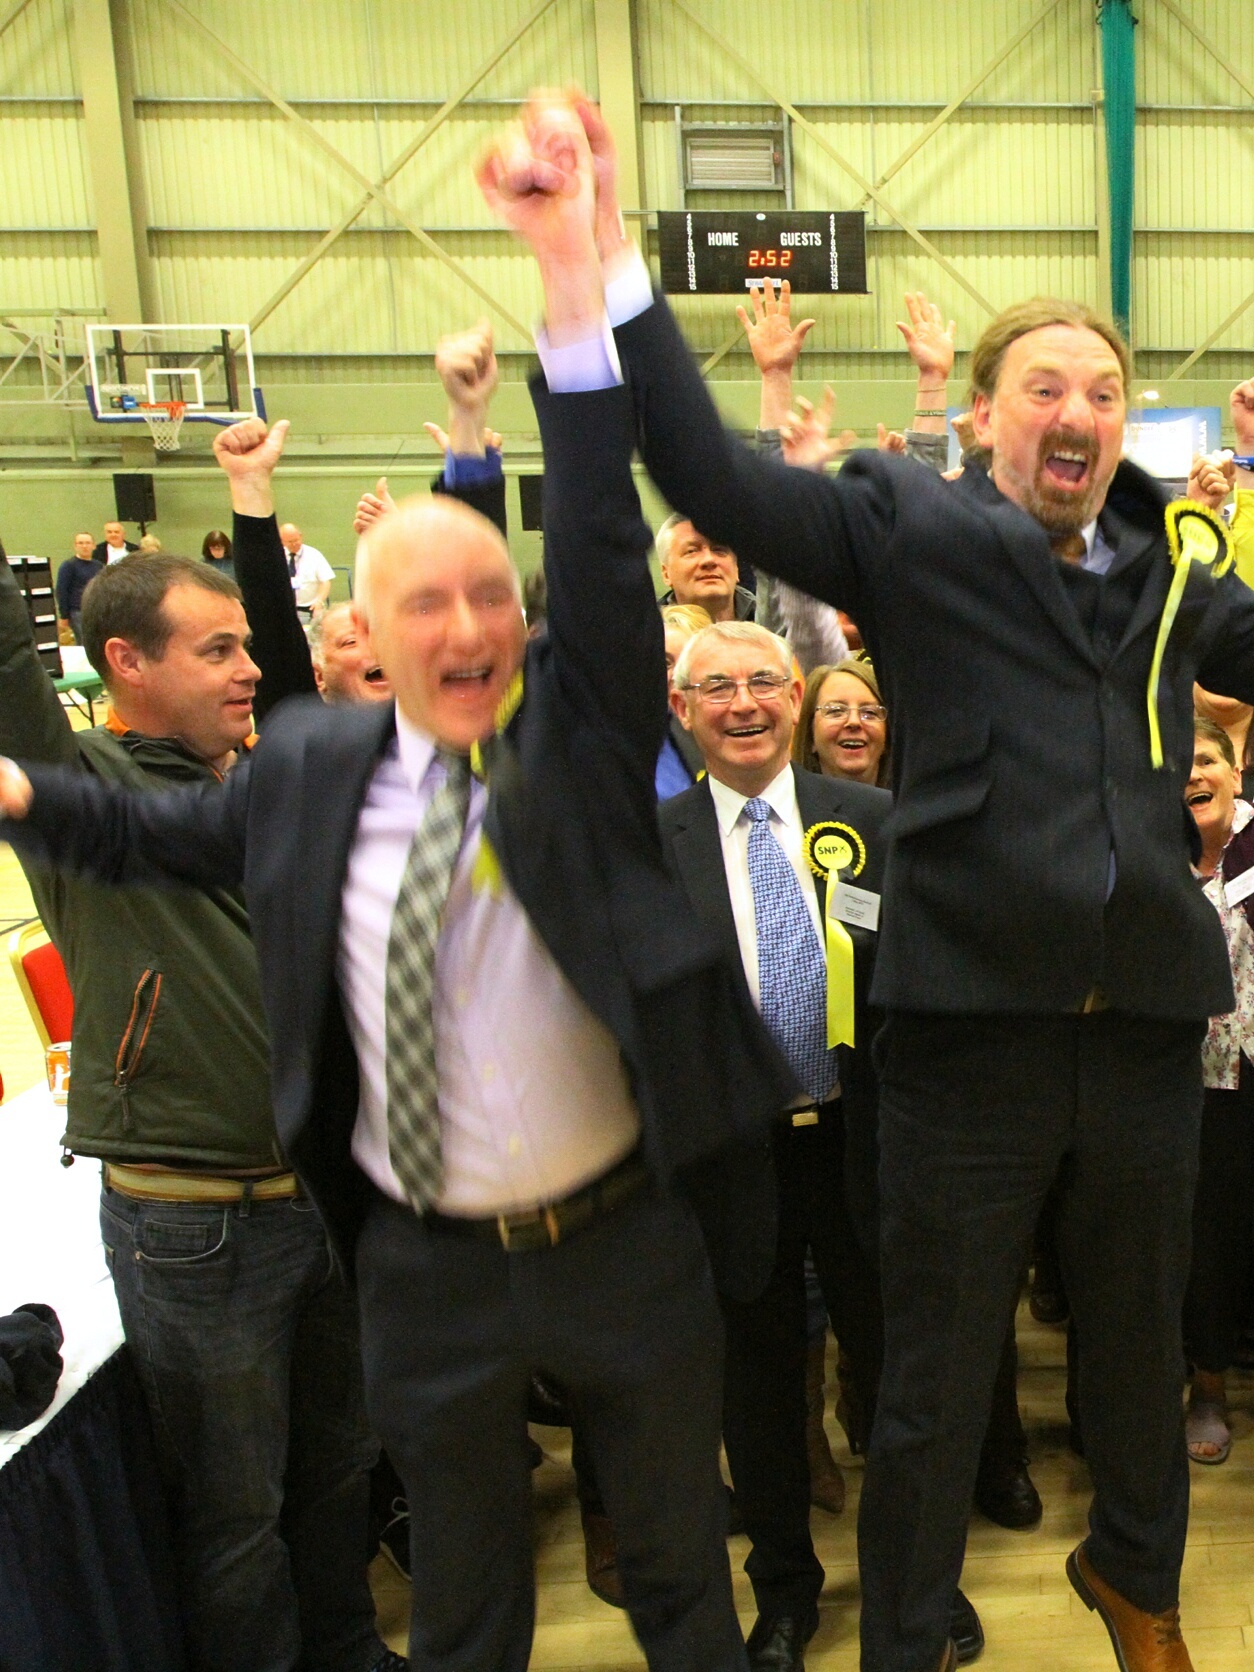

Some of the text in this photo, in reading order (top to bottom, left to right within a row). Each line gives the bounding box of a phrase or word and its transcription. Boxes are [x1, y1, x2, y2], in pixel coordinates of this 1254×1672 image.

[708, 232, 739, 246] HOME
[780, 232, 822, 246] GUESTS
[749, 250, 791, 267] 2:52
[818, 846, 838, 855] SNP
